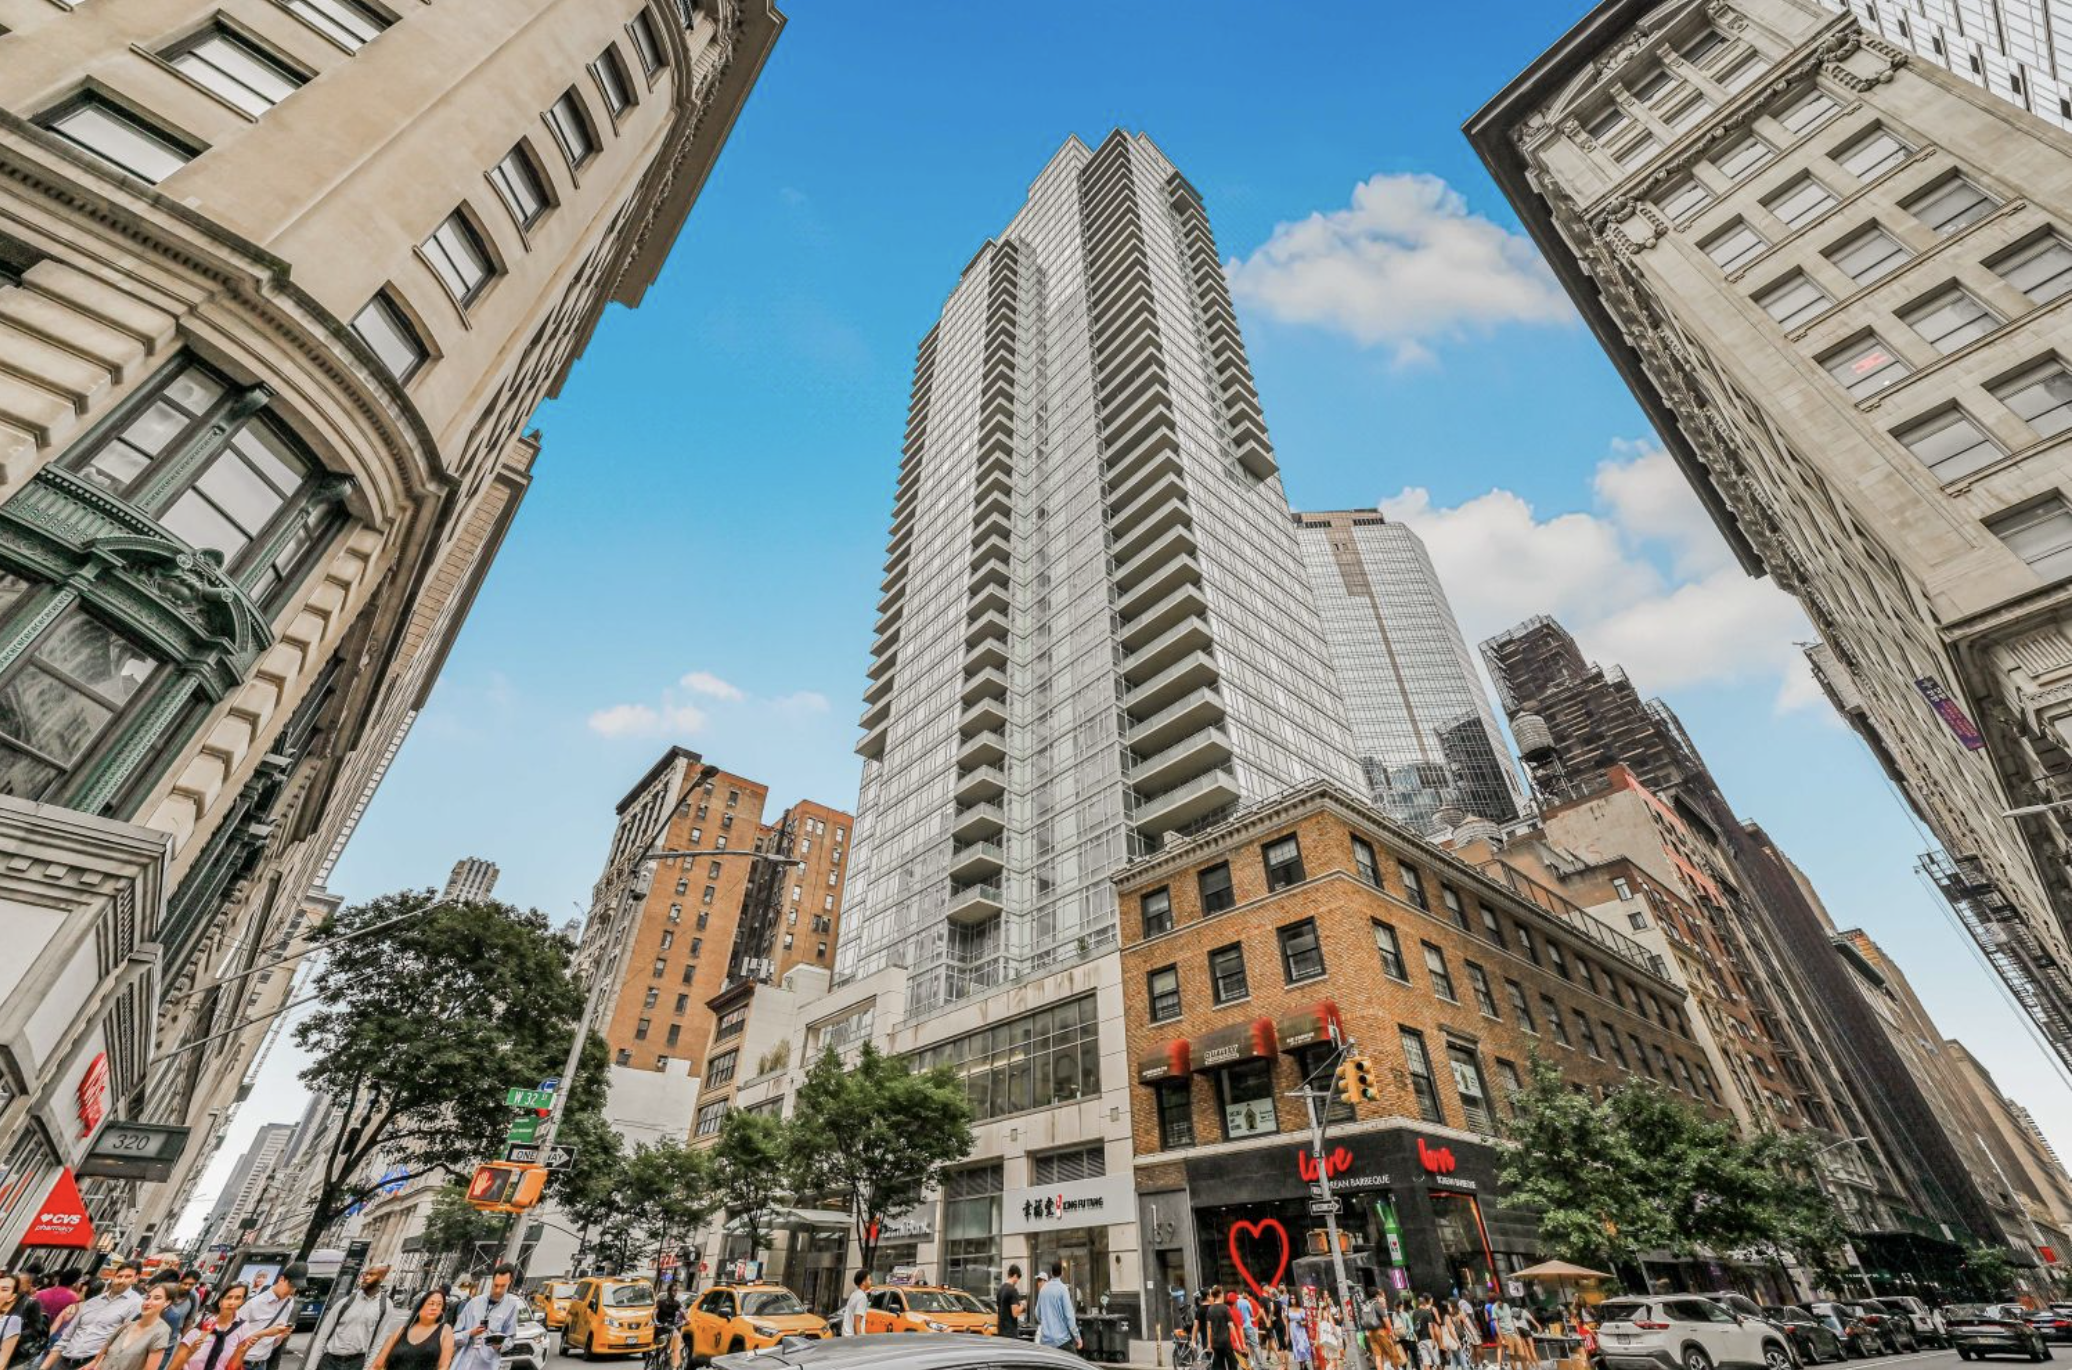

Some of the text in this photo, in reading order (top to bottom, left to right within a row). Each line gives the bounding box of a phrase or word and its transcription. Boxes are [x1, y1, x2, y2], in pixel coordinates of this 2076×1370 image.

[514, 1091, 523, 1104] W
[525, 1092, 538, 1105] 32
[113, 1134, 150, 1150] 320
[516, 1150, 536, 1160] ONE
[1351, 1175, 1390, 1188] BARBEQUE
[53, 1214, 82, 1225] CVS
[35, 1225, 75, 1233] pharmacy
